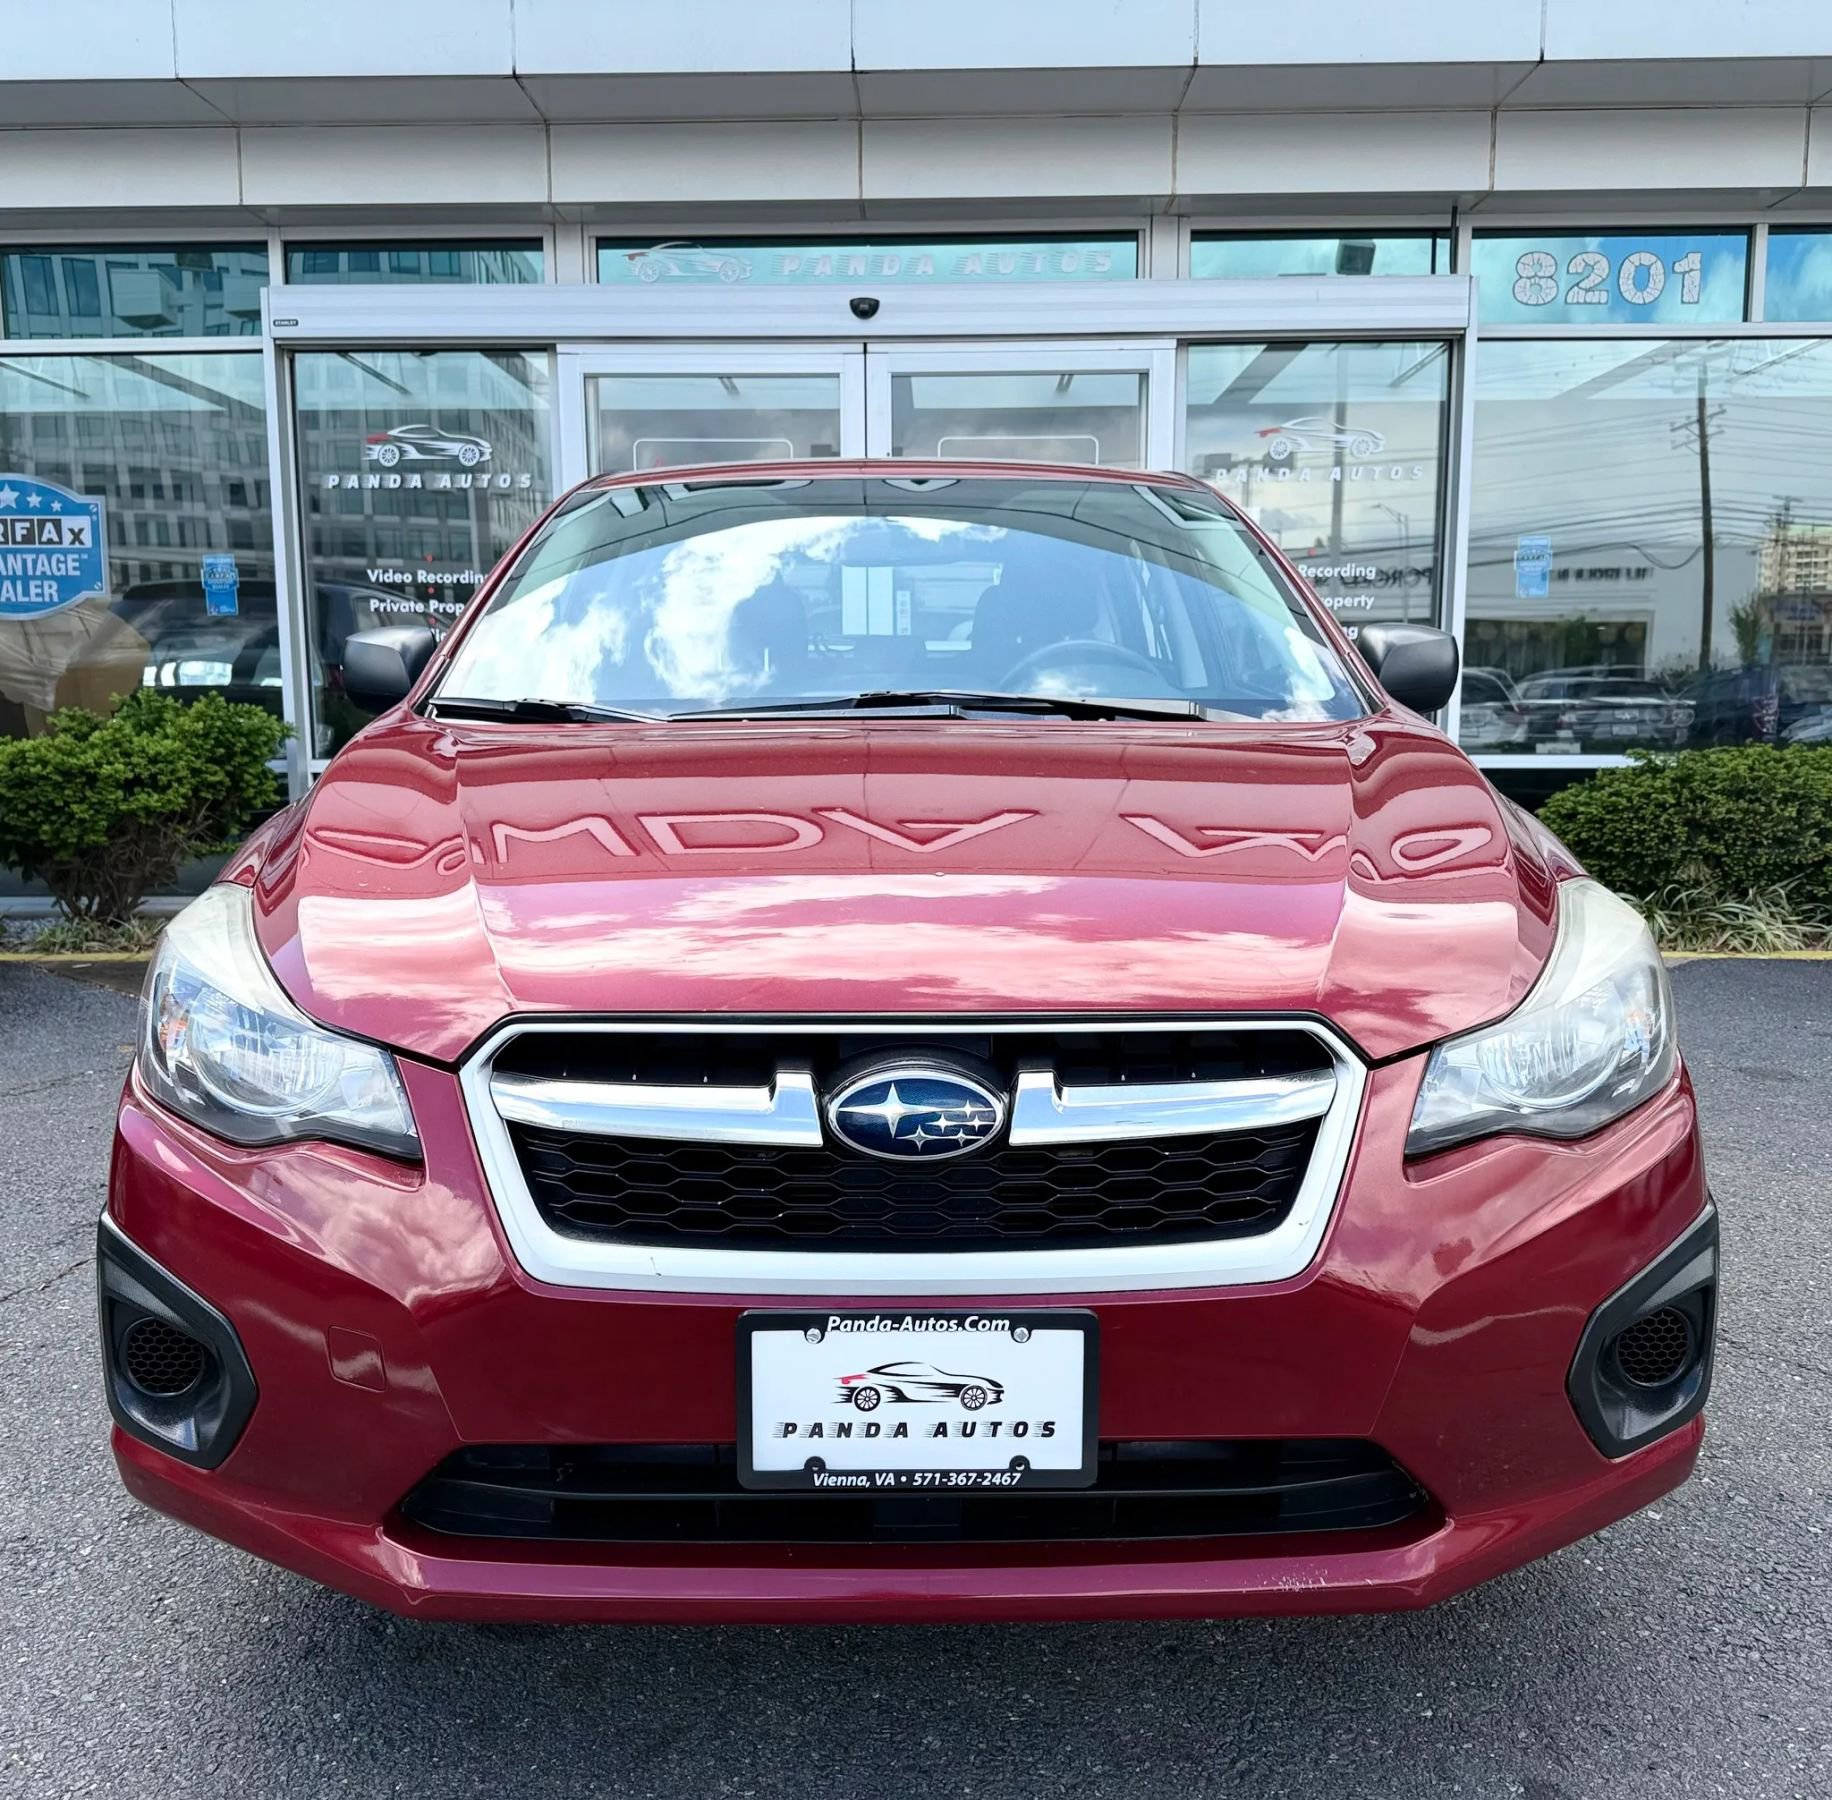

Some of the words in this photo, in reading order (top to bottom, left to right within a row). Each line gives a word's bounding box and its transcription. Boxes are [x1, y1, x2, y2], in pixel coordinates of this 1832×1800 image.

[774, 253, 934, 276] PANDA
[956, 250, 1112, 275] AUTOS
[1512, 251, 1702, 306] 8201
[325, 473, 422, 489] PANDA
[437, 473, 533, 489] AUTOS
[1215, 467, 1311, 482] PANDA
[1329, 466, 1424, 481] AUTOS
[367, 568, 413, 583] Video
[417, 569, 489, 584] Recordin
[1298, 563, 1376, 580] Recording
[369, 599, 425, 613] Private
[429, 600, 464, 616] Prop
[826, 1315, 1011, 1333] Panda-Autos.Com
[776, 1421, 909, 1439] PANDA
[927, 1420, 1057, 1438] AUTOS
[813, 1472, 872, 1488] Vienna,
[874, 1472, 896, 1486] VA
[912, 1471, 1022, 1487] 571-367-2467
